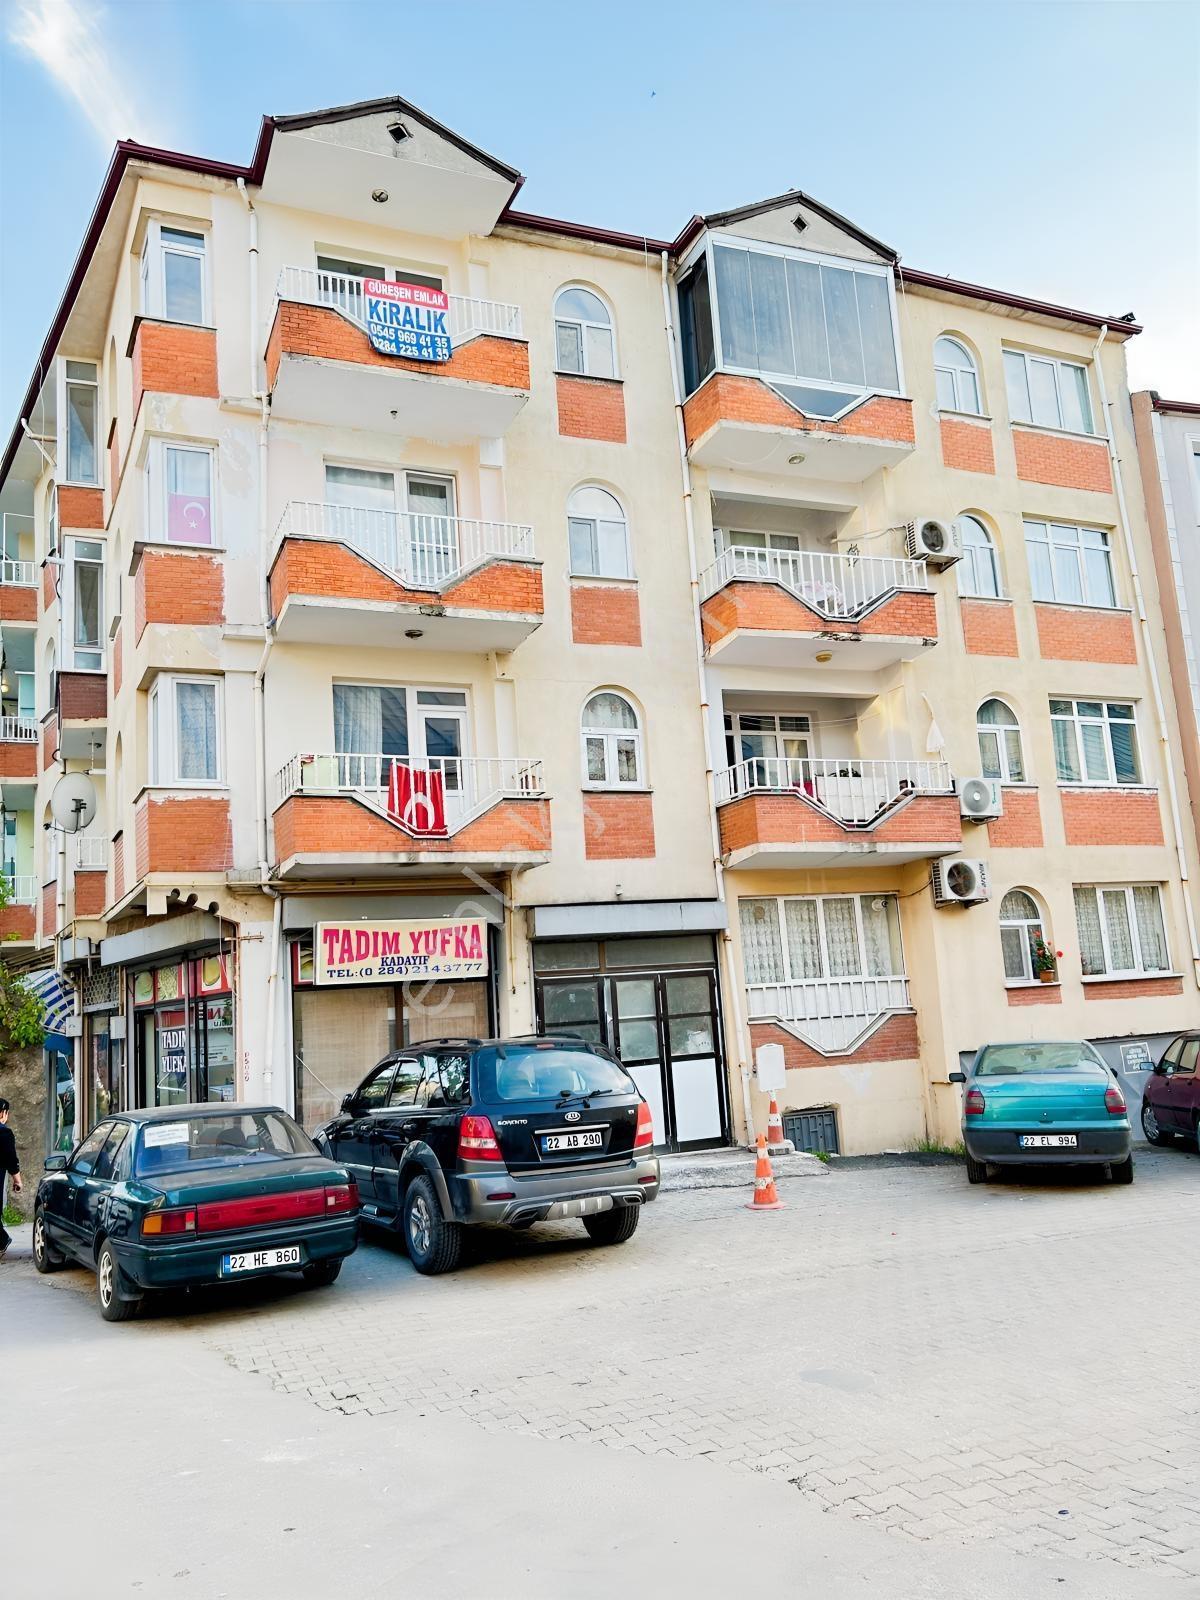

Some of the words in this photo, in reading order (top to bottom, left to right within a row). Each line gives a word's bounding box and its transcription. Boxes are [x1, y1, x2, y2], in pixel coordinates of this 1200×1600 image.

[368, 281, 411, 299] GÜREŞEN
[414, 291, 444, 306] EMLAK
[370, 324, 396, 339] 0545
[398, 330, 416, 344] 969
[419, 335, 431, 346] 41
[435, 337, 448, 347] 35
[399, 343, 419, 356] 225
[422, 347, 433, 358] 41
[436, 348, 449, 360] 35
[323, 928, 401, 966] TADIM
[408, 924, 483, 959] YUFKA
[380, 955, 430, 967] KADAYIF
[547, 1137, 560, 1149] 22
[566, 1135, 579, 1148] AB
[583, 1133, 601, 1146] 290
[1023, 1136, 1035, 1146] 22
[1041, 1136, 1053, 1146] EL
[1058, 1136, 1076, 1146] 994
[230, 1256, 245, 1269] 22
[253, 1252, 268, 1266] HE
[276, 1248, 298, 1263] 860
